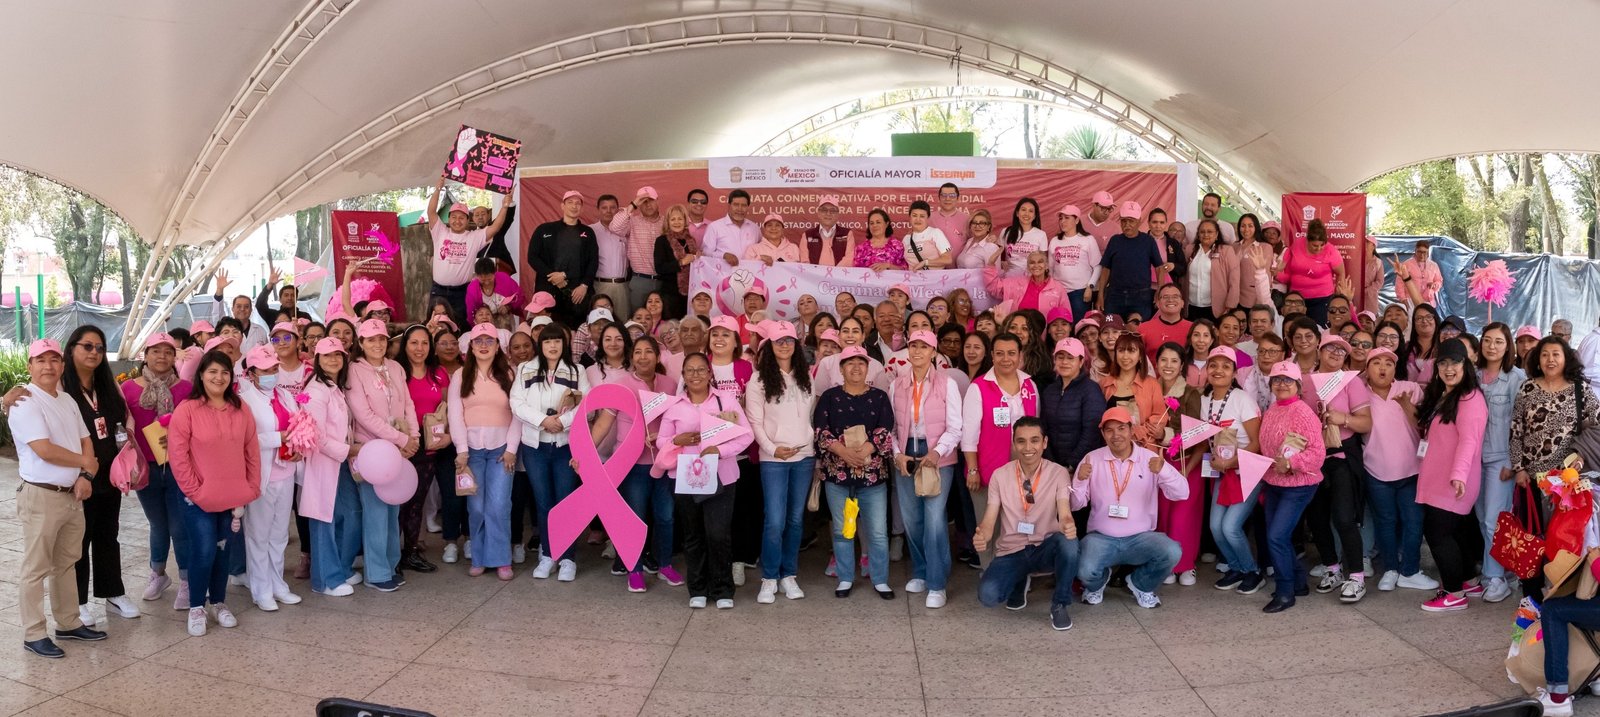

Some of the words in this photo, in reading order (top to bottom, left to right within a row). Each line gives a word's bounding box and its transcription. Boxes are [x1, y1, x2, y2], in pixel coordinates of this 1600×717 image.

[829, 168, 881, 179] OFICIALÍA
[885, 170, 921, 178] MAYOR
[874, 194, 897, 202] POR
[900, 194, 913, 202] EL
[915, 192, 935, 202] DÍA
[752, 206, 766, 215] LA
[769, 206, 805, 215] LUCHA
[856, 206, 869, 214] EL
